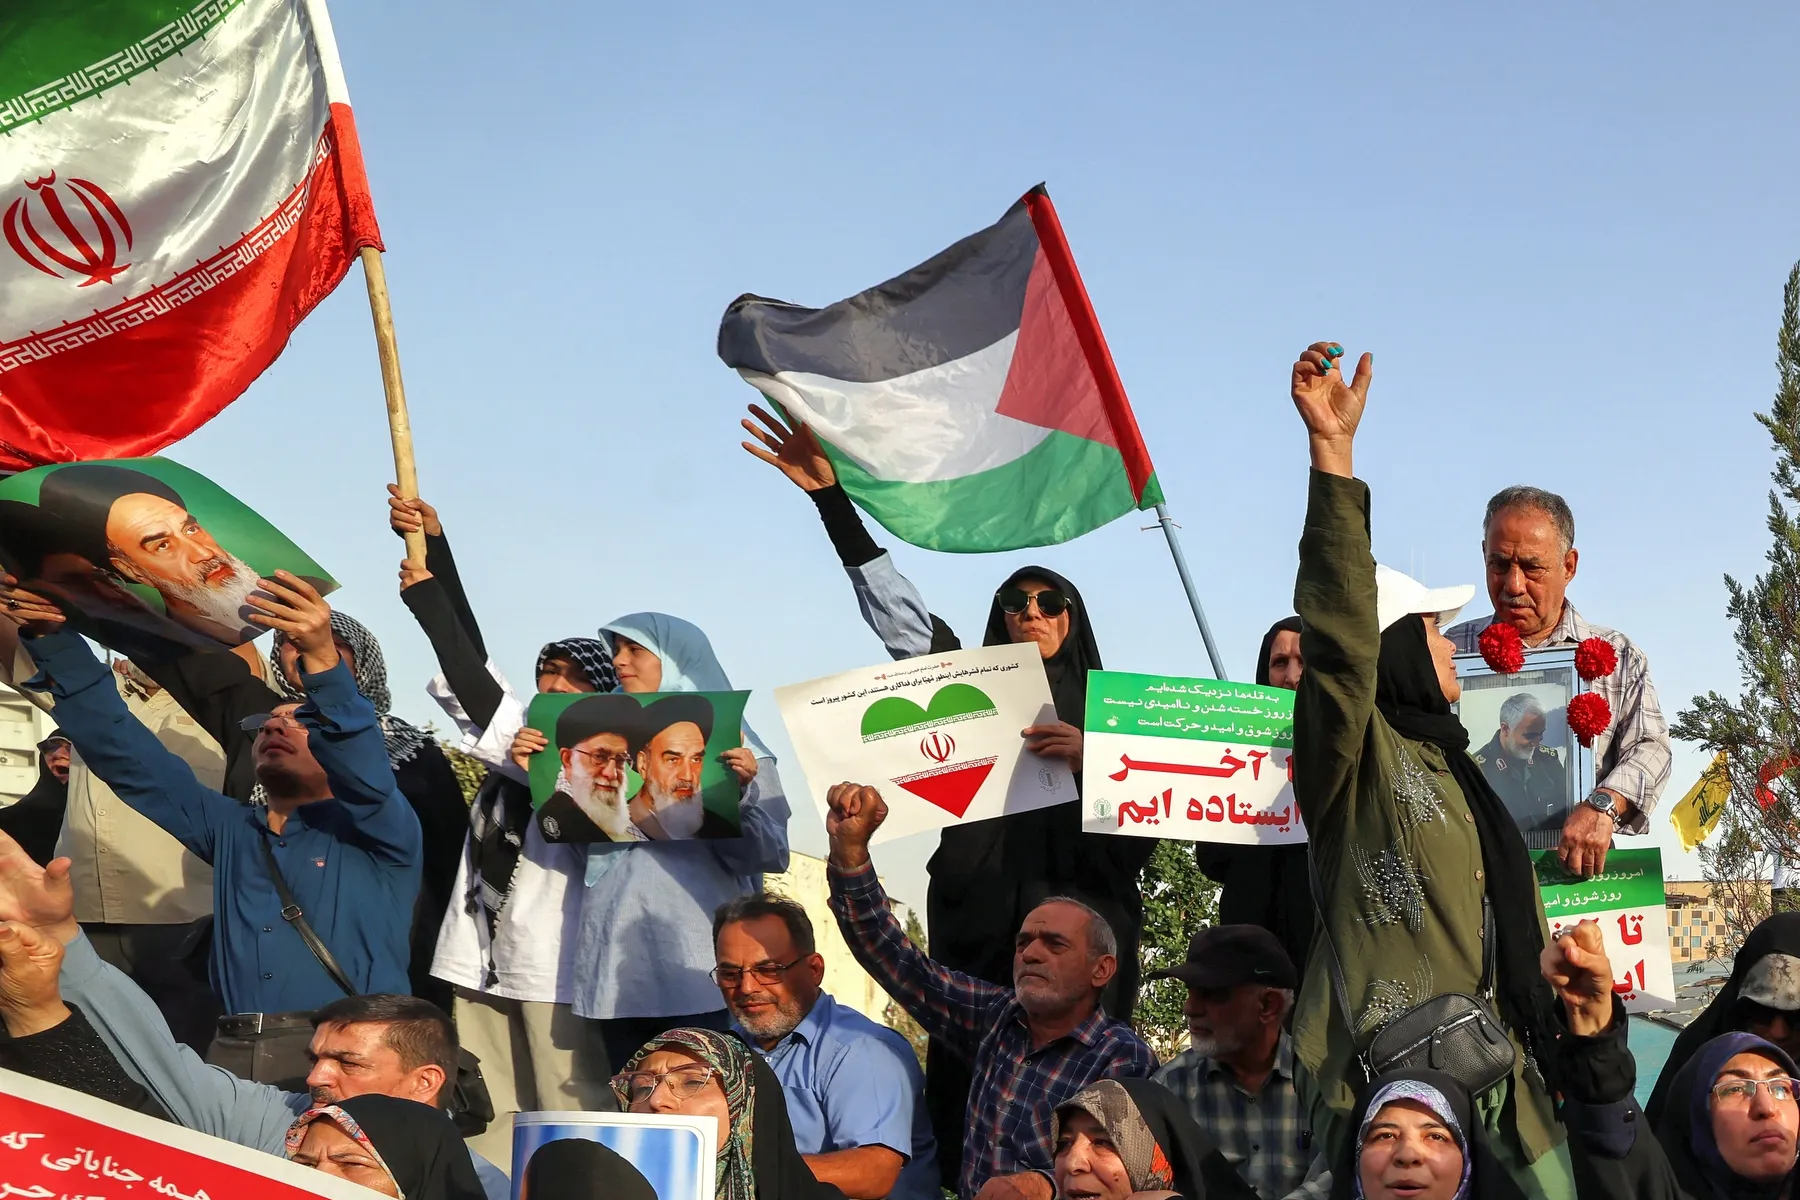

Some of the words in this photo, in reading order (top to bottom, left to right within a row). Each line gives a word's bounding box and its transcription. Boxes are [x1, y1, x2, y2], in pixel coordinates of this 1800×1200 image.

[1188, 684, 1232, 698] نزدیک
[1103, 697, 1142, 706] نیست
[1144, 698, 1190, 710] ناامیدی
[1265, 695, 1279, 704] به
[1201, 703, 1226, 714] شدن
[1227, 705, 1263, 716] خسته
[1264, 706, 1285, 719] روز
[1138, 716, 1163, 727] است
[1164, 717, 1200, 733] حرکت
[1208, 722, 1234, 735] امید
[1246, 723, 1271, 737] شوق
[1272, 728, 1294, 740] روز
[1108, 748, 1268, 782] آخر
[1118, 788, 1172, 827] ایم
[1611, 868, 1644, 881] امروز
[1572, 890, 1600, 906] شوق
[1600, 889, 1622, 902] روز
[1617, 913, 1644, 945] تا
[1, 1131, 46, 1150] که
[40, 1147, 145, 1189] جنایاتی
